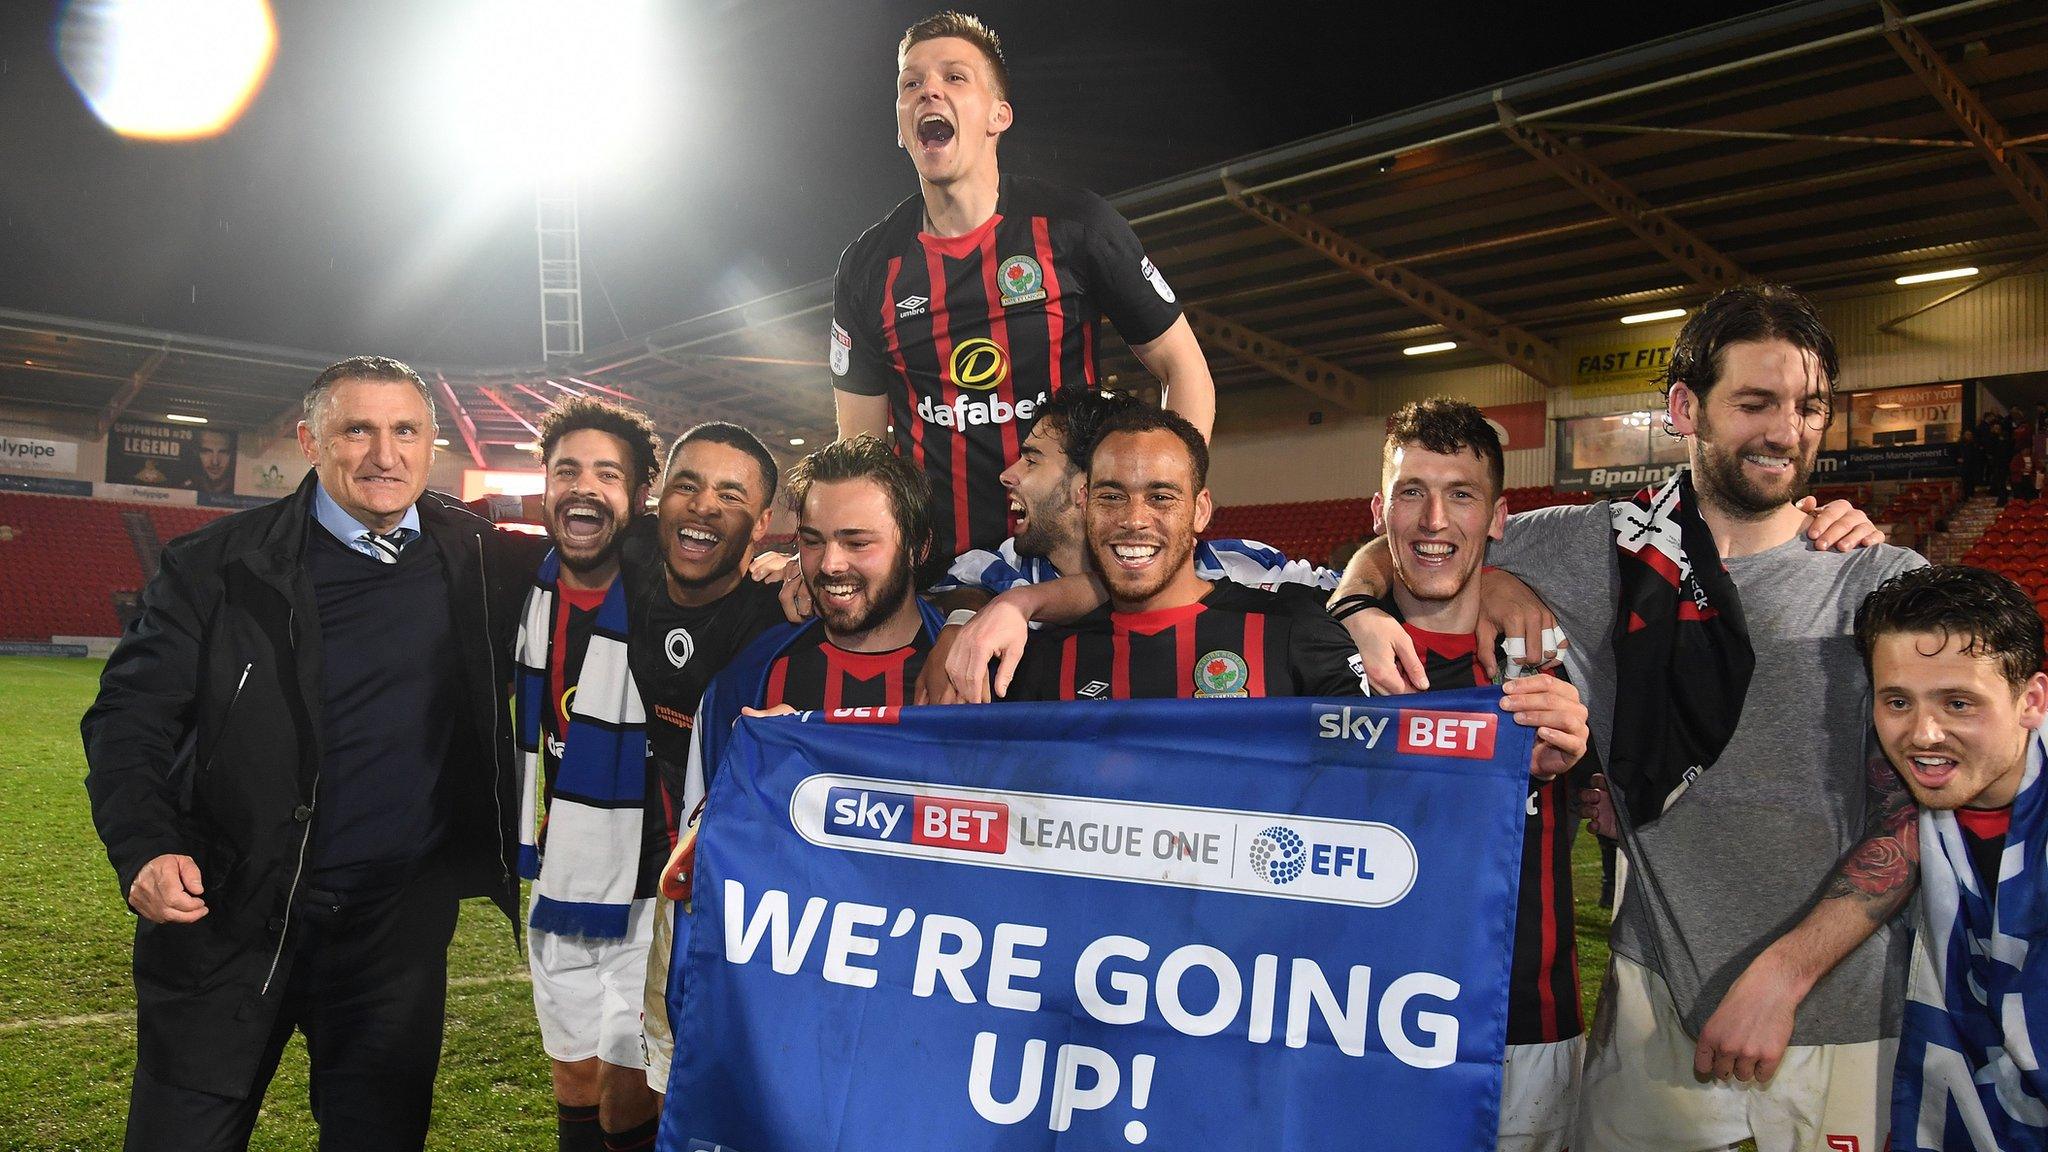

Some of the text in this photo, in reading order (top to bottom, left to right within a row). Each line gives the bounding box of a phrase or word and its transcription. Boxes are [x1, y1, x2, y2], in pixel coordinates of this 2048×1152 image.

[900, 307, 926, 319] umbro
[1578, 346, 1671, 375] FAST FIT
[1933, 388, 1958, 400] YOU
[124, 437, 180, 456] LEGEND
[1886, 449, 1939, 461] Management
[1319, 706, 1487, 750] sky BET
[834, 791, 999, 844] sky BET
[1019, 816, 1220, 865] LEAGUE ONE
[1310, 843, 1375, 880] EFL
[724, 879, 1461, 1069] WE’RE GOING
[968, 1031, 1156, 1145] UP!
